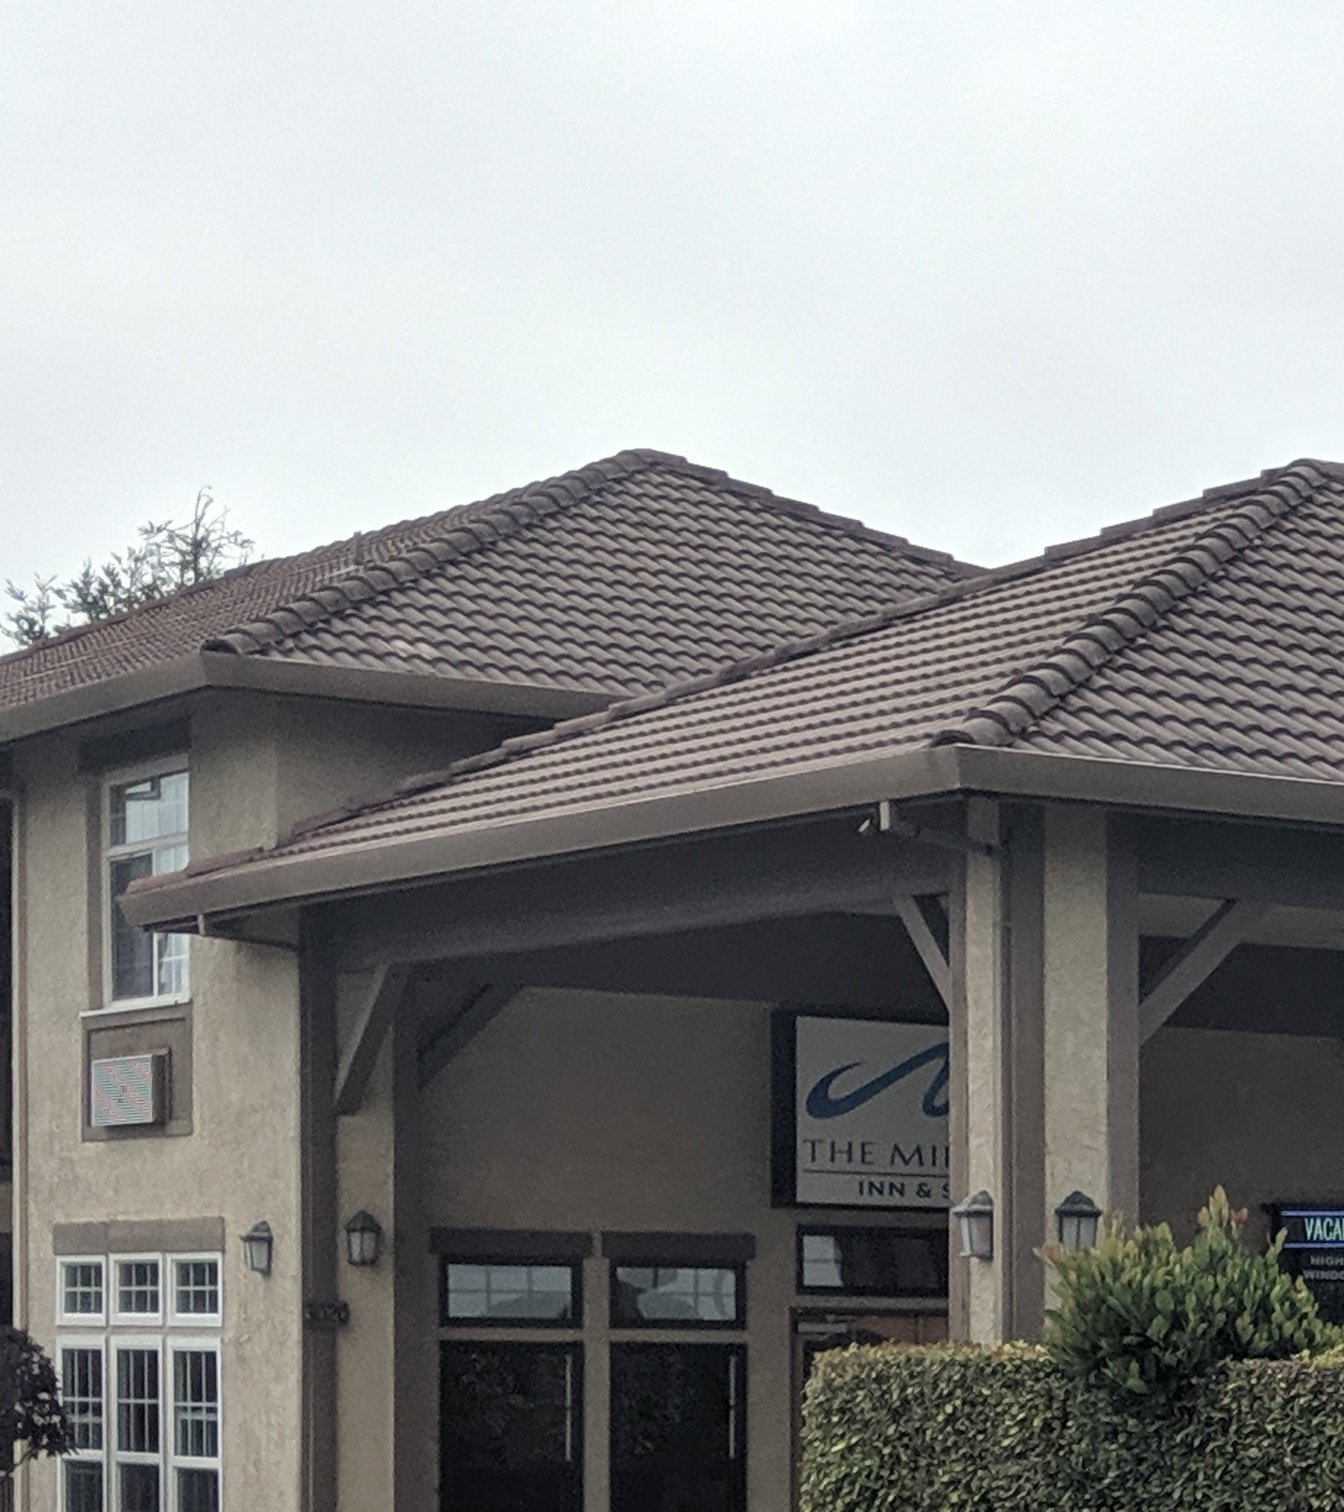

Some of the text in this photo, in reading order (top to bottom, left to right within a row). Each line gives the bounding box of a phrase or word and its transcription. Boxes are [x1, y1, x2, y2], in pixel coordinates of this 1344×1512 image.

[803, 1139, 950, 1170] THE MI
[858, 1180, 906, 1198] INN
[916, 1182, 931, 1199] &
